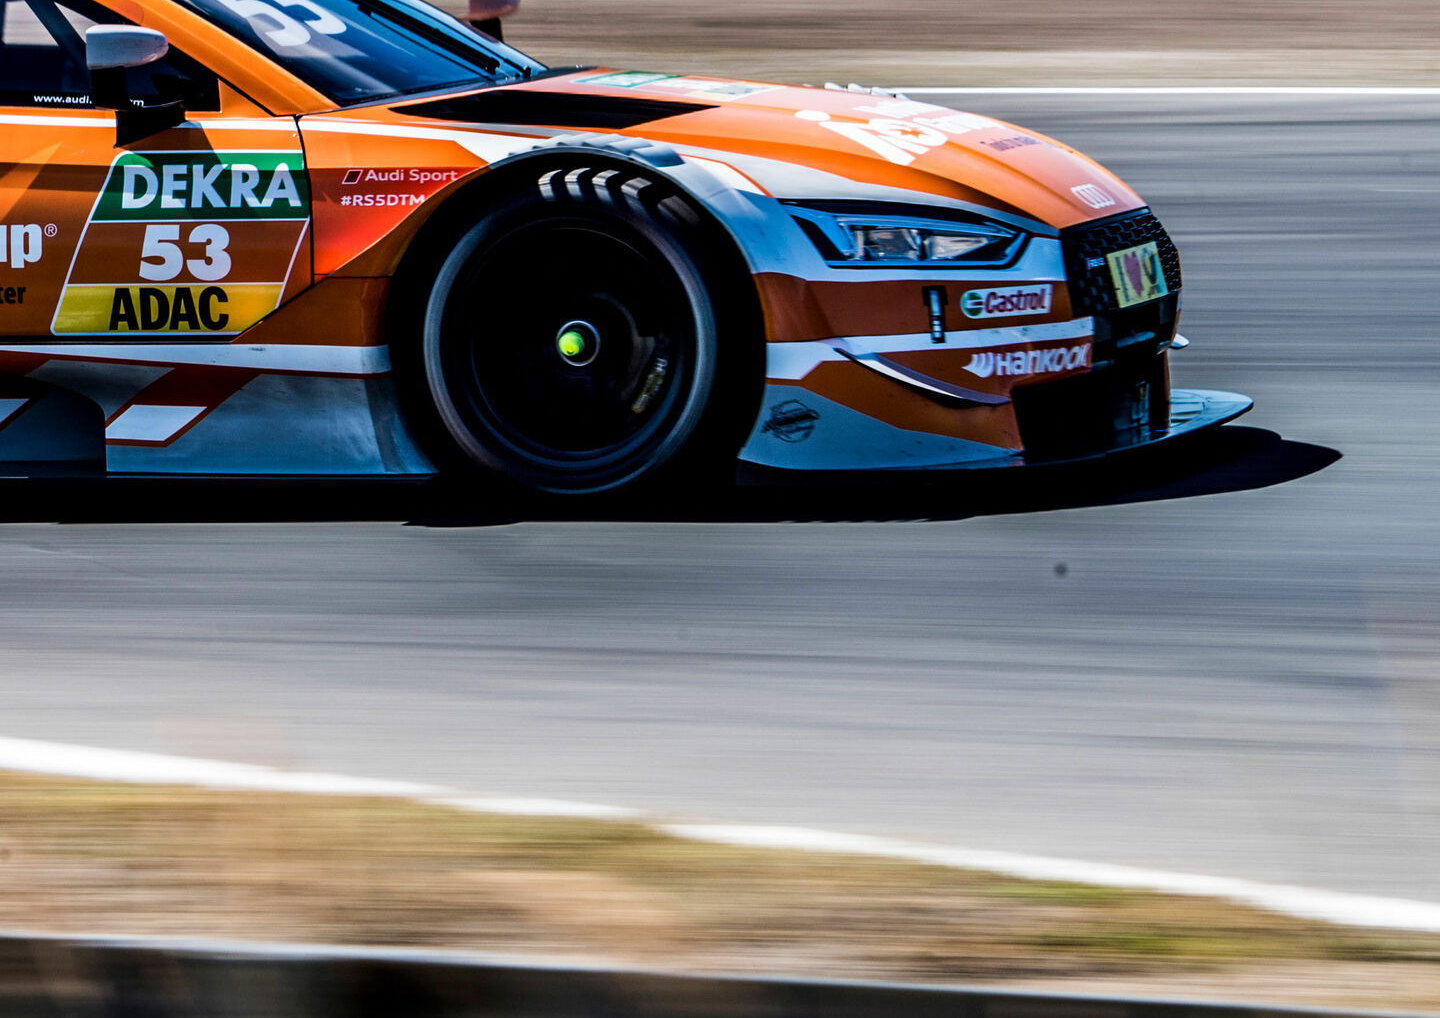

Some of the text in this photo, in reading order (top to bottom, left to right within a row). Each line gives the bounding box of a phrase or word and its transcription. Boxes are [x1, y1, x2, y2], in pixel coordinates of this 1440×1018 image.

[121, 162, 302, 209] DEKRA
[365, 169, 458, 183] Audi Sport
[341, 194, 425, 206] #RS5DTM
[139, 223, 232, 282] 53
[109, 286, 229, 331] ADAC
[984, 288, 1046, 314] Castrol
